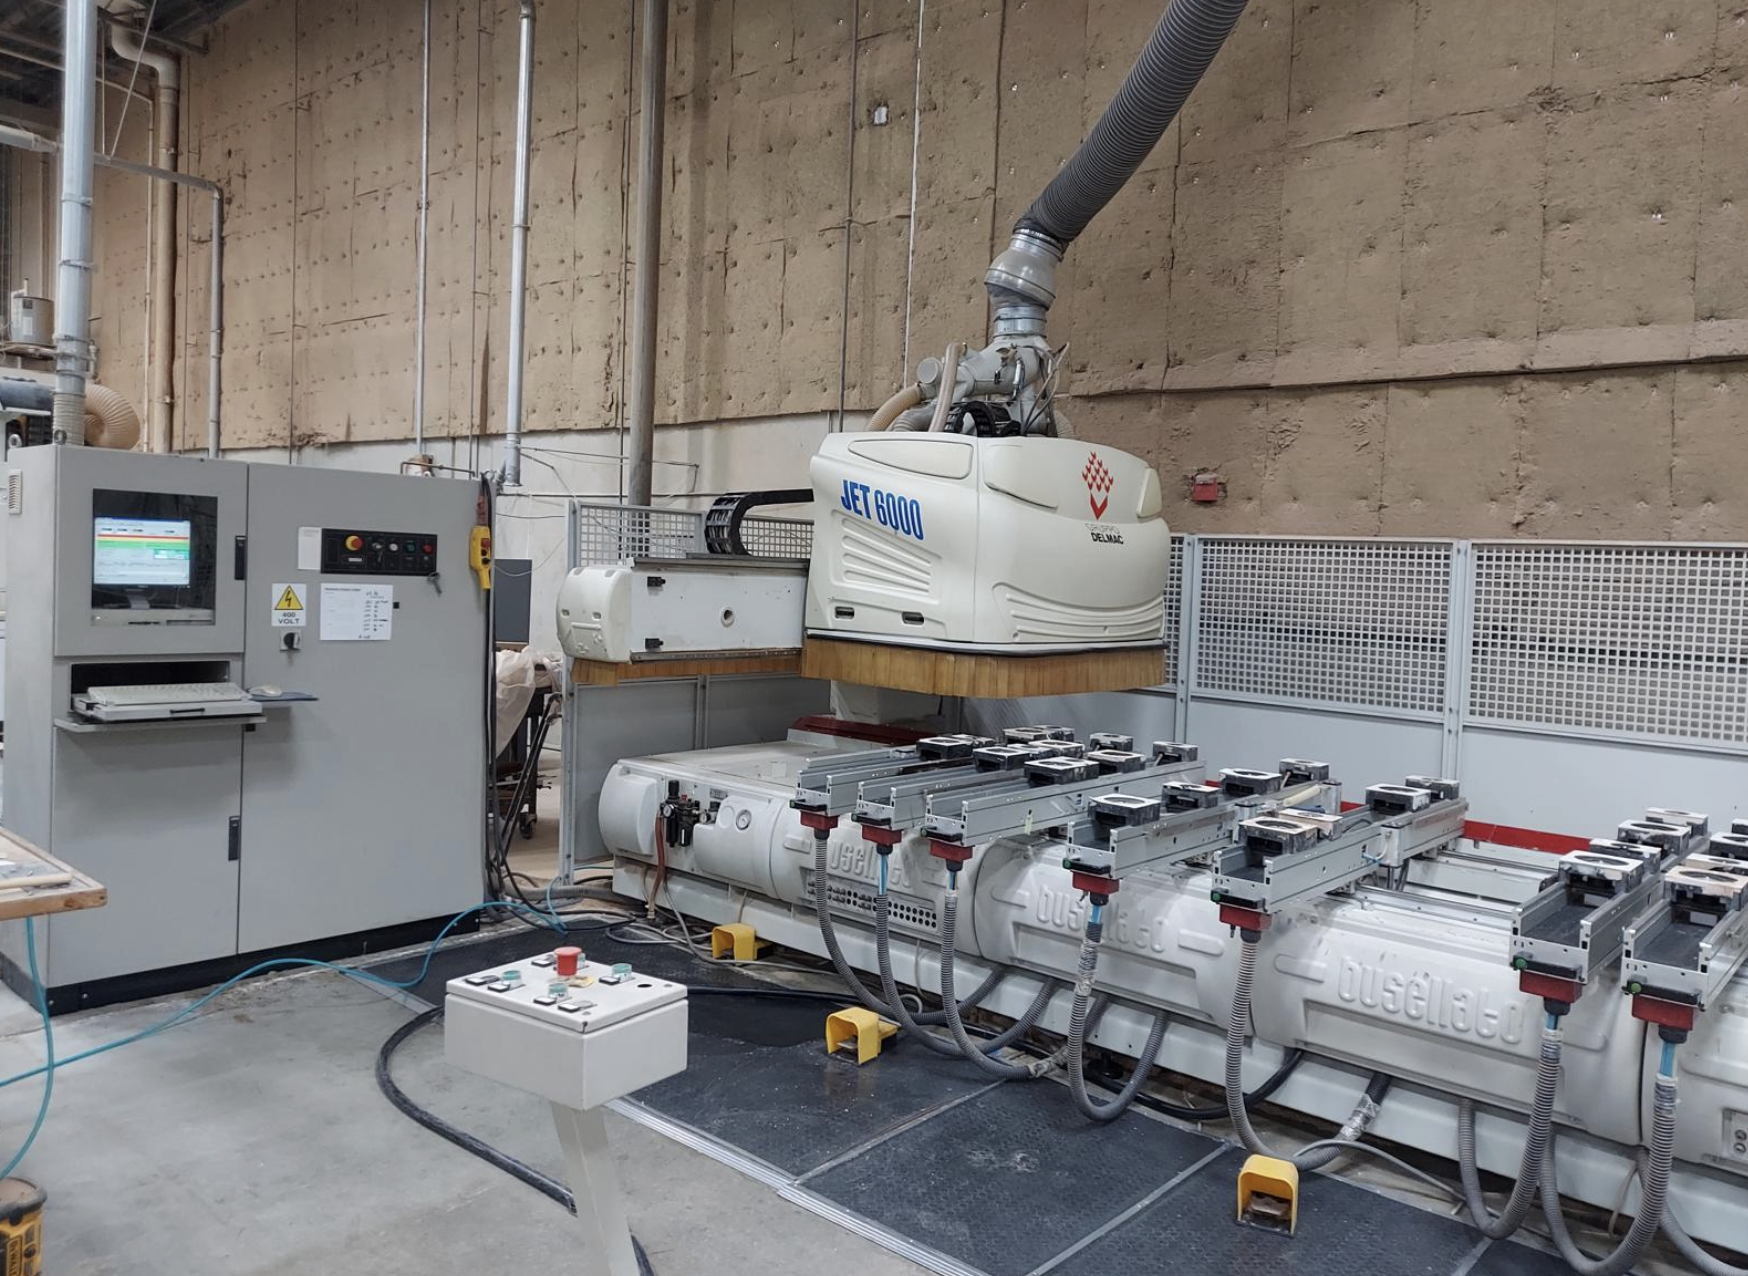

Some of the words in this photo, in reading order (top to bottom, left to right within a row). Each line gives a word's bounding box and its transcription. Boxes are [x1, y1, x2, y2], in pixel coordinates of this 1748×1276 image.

[840, 479, 871, 520] JET
[874, 489, 924, 541] 6000
[1090, 532, 1124, 545] DELMAC
[1036, 885, 1166, 953] busllato
[1338, 954, 1524, 1045] busellato
